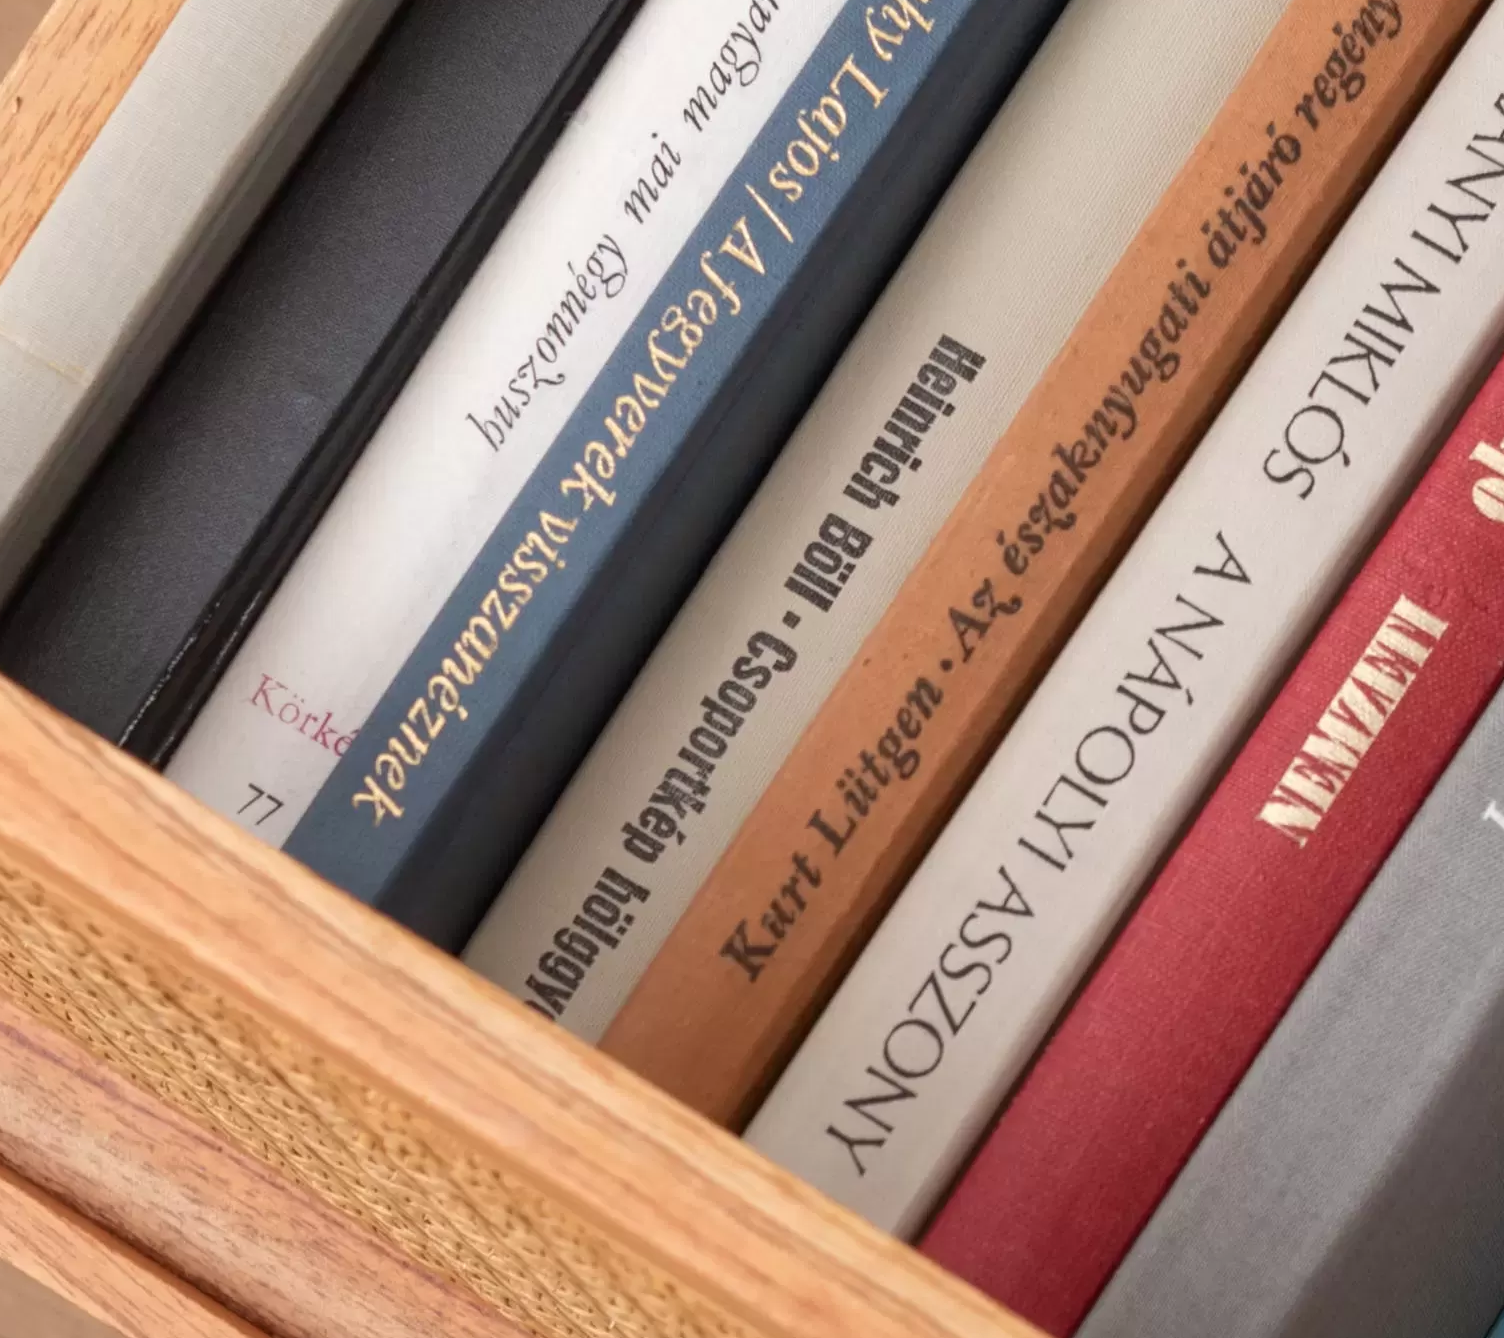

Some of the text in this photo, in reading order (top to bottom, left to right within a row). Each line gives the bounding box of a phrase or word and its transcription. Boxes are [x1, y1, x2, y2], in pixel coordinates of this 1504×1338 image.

[719, 217, 765, 274] A
[769, 53, 887, 202] Lajos
[466, 234, 628, 452] huszonnégy
[624, 132, 681, 224] mai
[561, 251, 741, 510] fegyverek
[1263, 258, 1441, 500] MIKLÓS
[843, 334, 986, 510] Heinrich
[353, 511, 578, 819] visszanéznek
[719, 853, 822, 984] Kurt
[806, 677, 944, 859] Lütgen
[949, 578, 1023, 664] Az
[996, 259, 1211, 576] északnyugati
[1200, 121, 1302, 270] átjáró
[784, 513, 873, 612] Böll
[1193, 531, 1251, 584] A
[238, 783, 284, 825] 77
[620, 631, 797, 864] Csoportkép
[1018, 594, 1224, 872] NÁPOLYI
[1259, 593, 1449, 848] NEMZETI
[825, 866, 1034, 1178] ASSZONY
